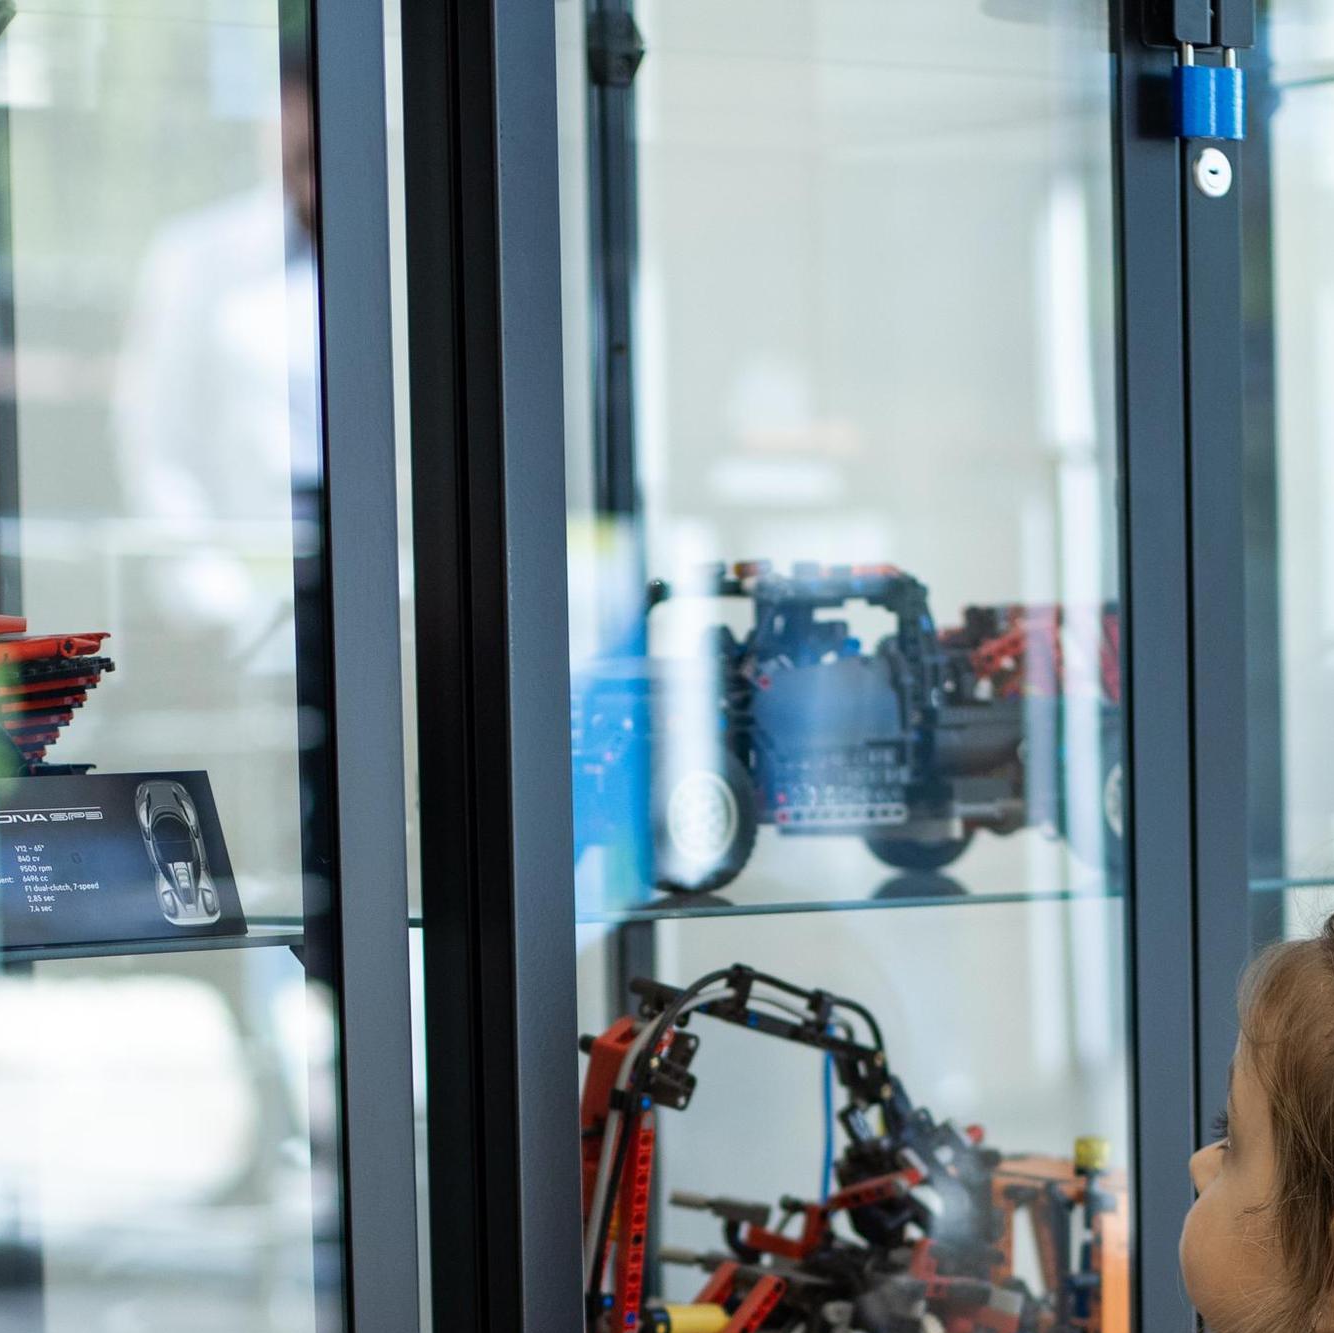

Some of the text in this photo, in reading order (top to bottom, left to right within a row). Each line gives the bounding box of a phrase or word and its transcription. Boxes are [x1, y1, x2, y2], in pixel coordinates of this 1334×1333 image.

[49, 811, 103, 822] SP3
[15, 845, 27, 853] V12
[18, 855, 30, 863] 840
[20, 865, 53, 873] 9500 rpm
[22, 875, 39, 883] 6496
[33, 883, 73, 894] dual-clutch,
[74, 881, 100, 893] 7-speed
[27, 895, 43, 903] 2.85
[43, 895, 56, 903] sec
[41, 905, 54, 913] sec
